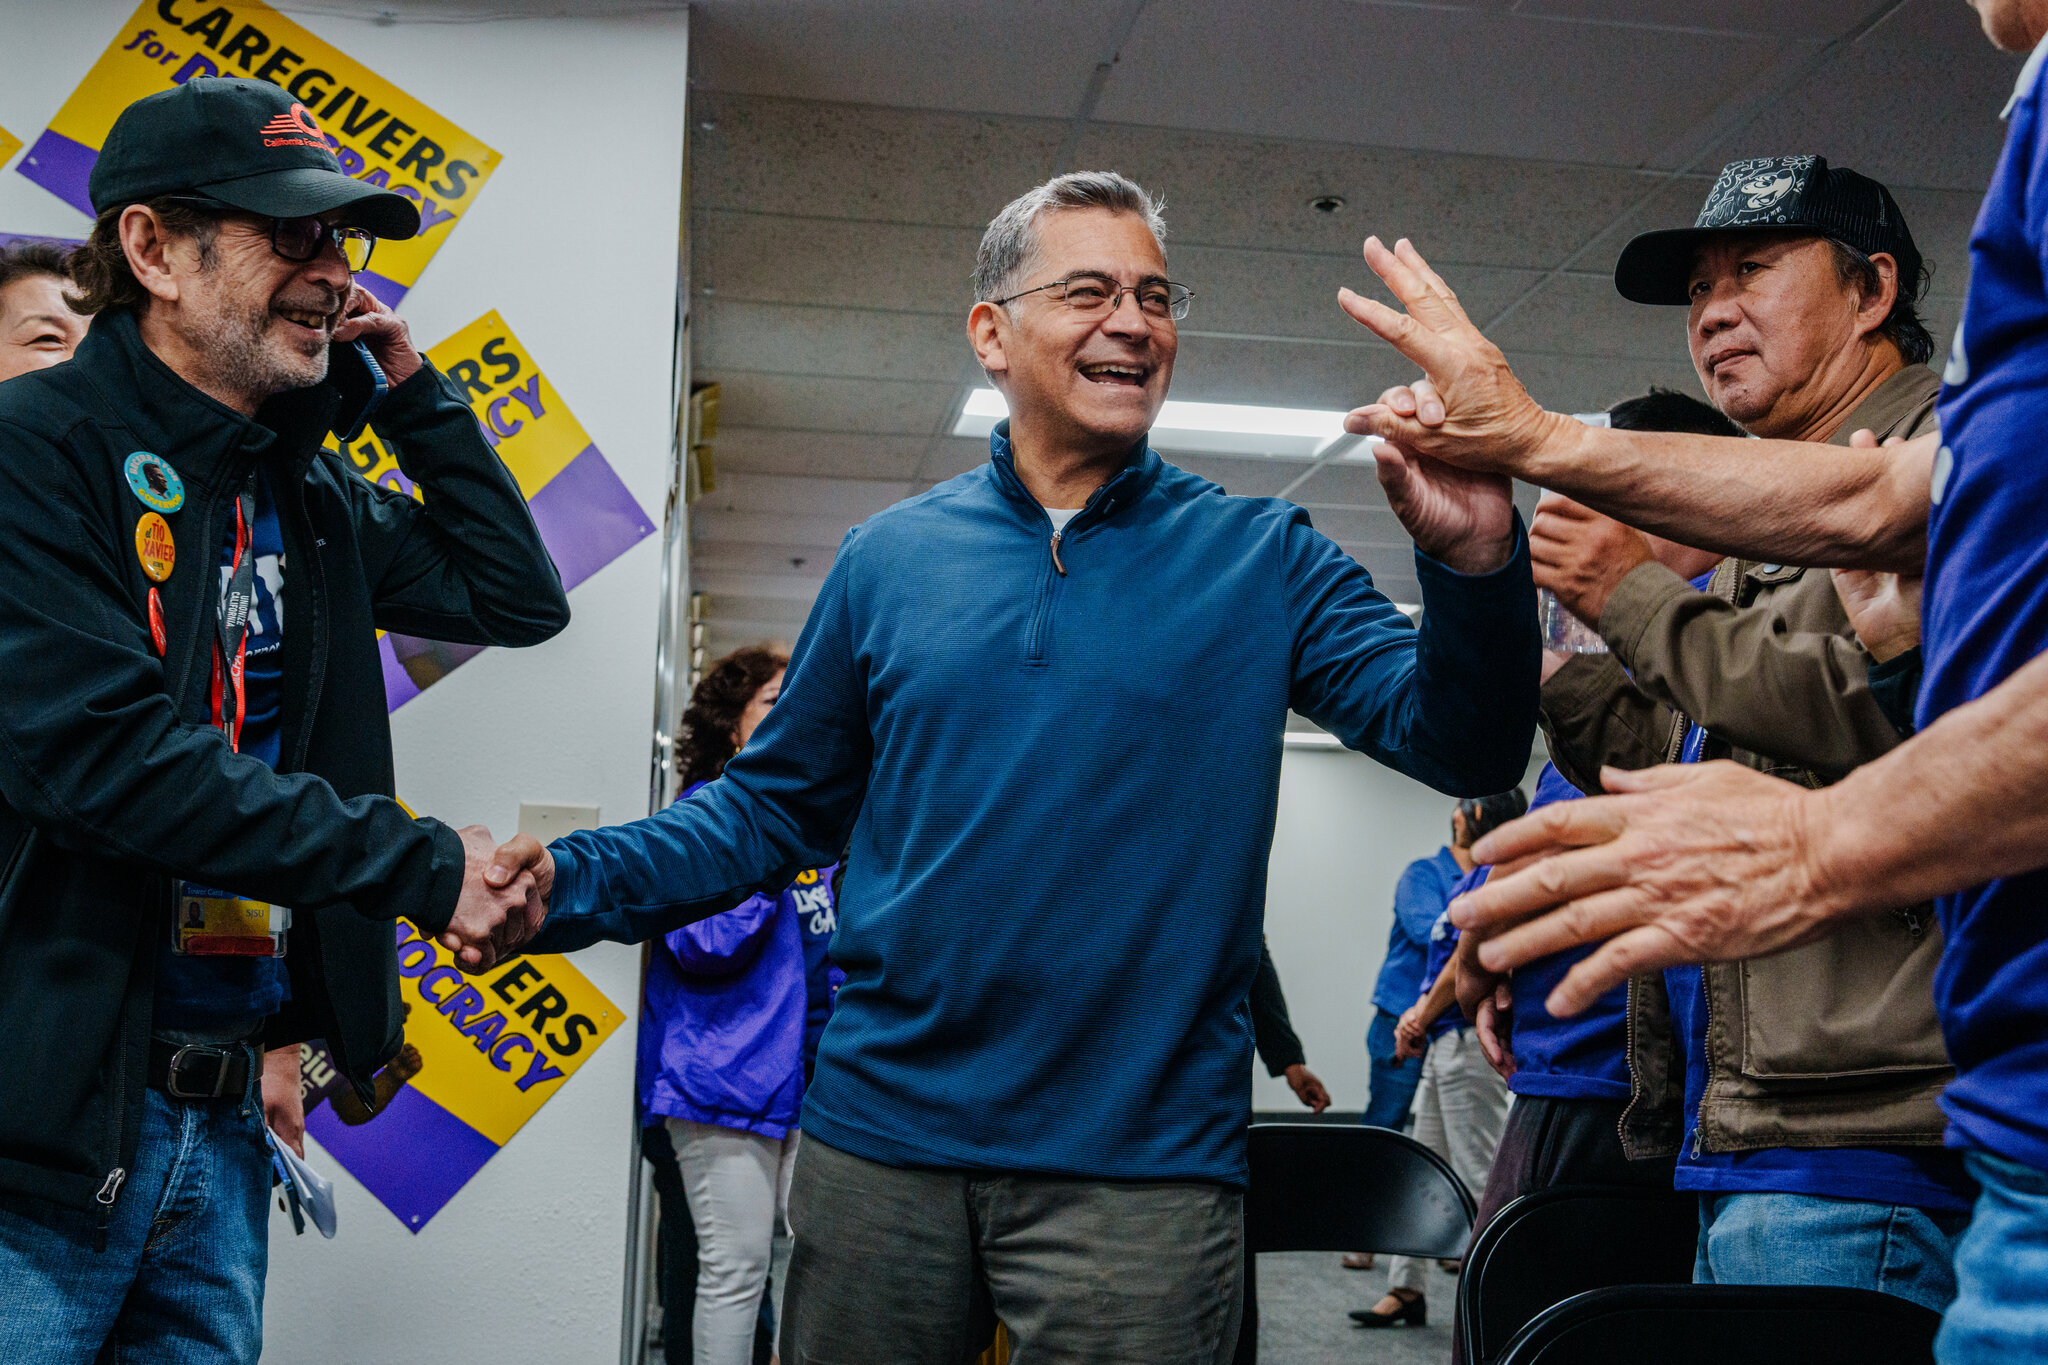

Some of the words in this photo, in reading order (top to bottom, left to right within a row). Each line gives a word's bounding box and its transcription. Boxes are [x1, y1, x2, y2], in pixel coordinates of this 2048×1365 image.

[123, 29, 180, 66] for
[157, 0, 479, 200] CAREGIVERS
[143, 538, 175, 563] XAVIER
[236, 595, 249, 627] UNIONIZE
